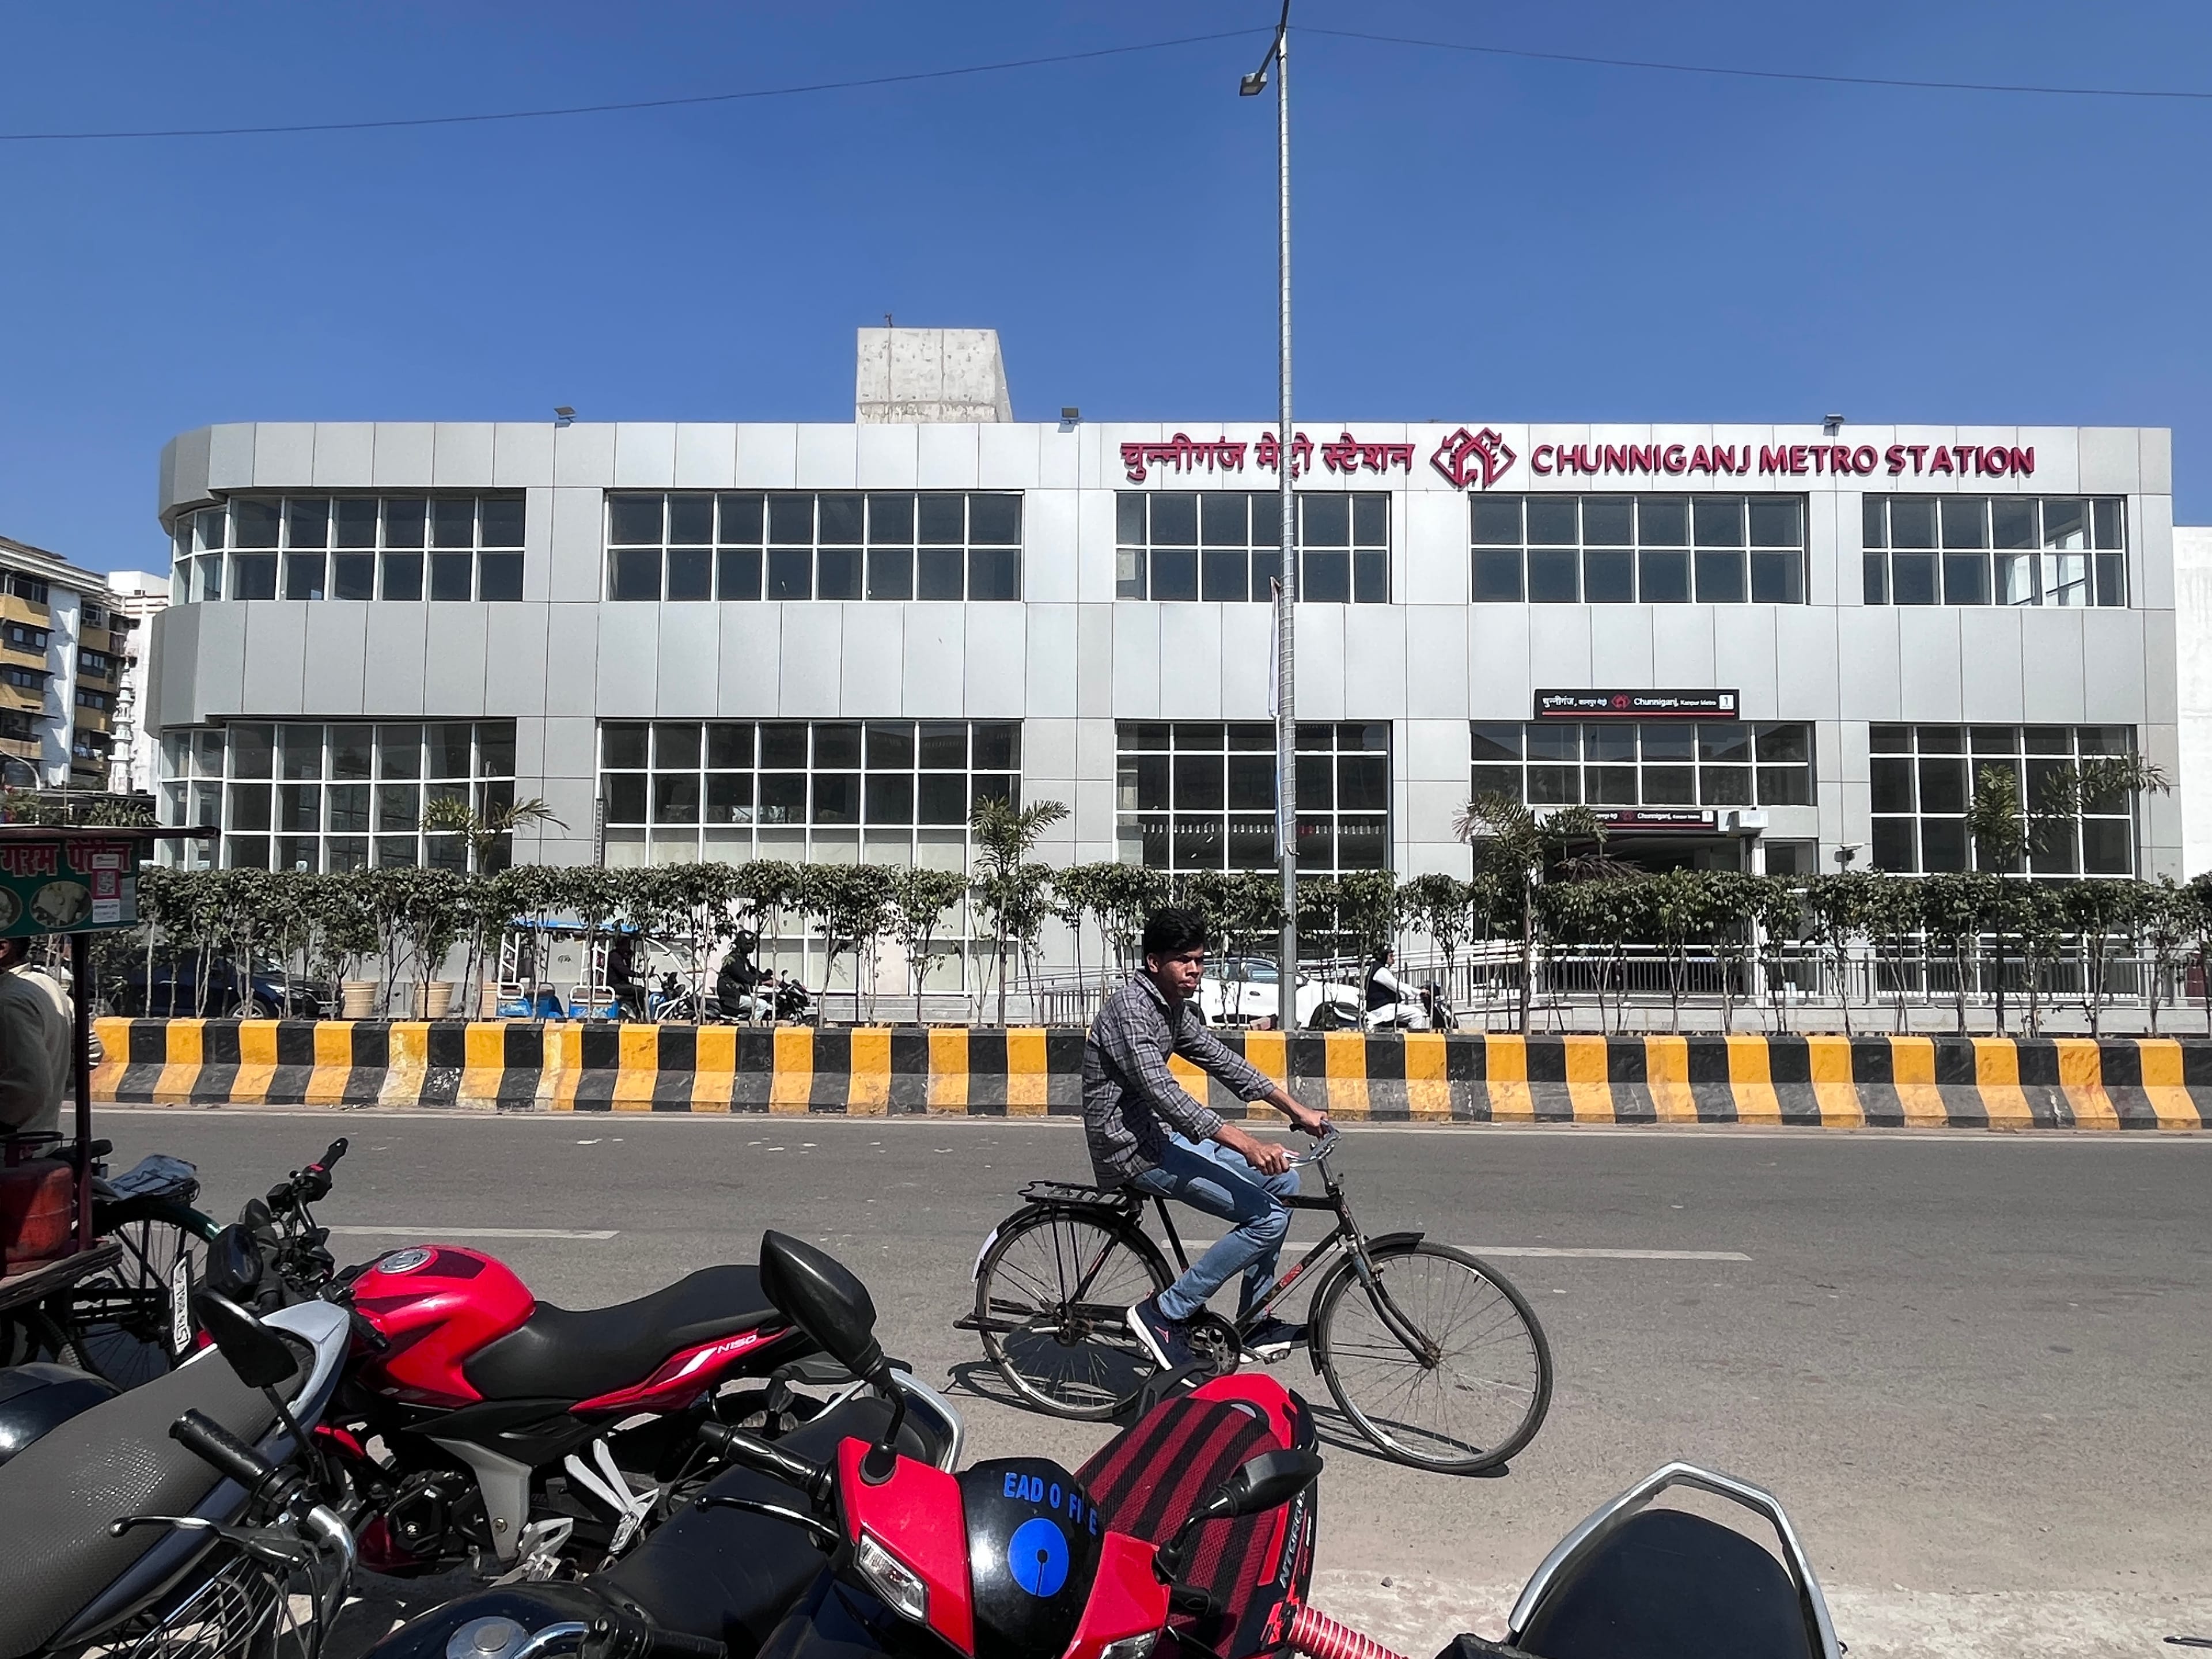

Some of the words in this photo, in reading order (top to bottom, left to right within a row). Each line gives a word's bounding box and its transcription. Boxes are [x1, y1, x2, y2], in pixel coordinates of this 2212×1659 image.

[1120, 433, 1247, 482] चुन्नीगंज
[1321, 433, 1415, 471] स्टेशन
[1531, 444, 1751, 474] CHUNNIGANJ
[1759, 445, 1878, 474] METRO
[1885, 445, 2035, 476] STATION
